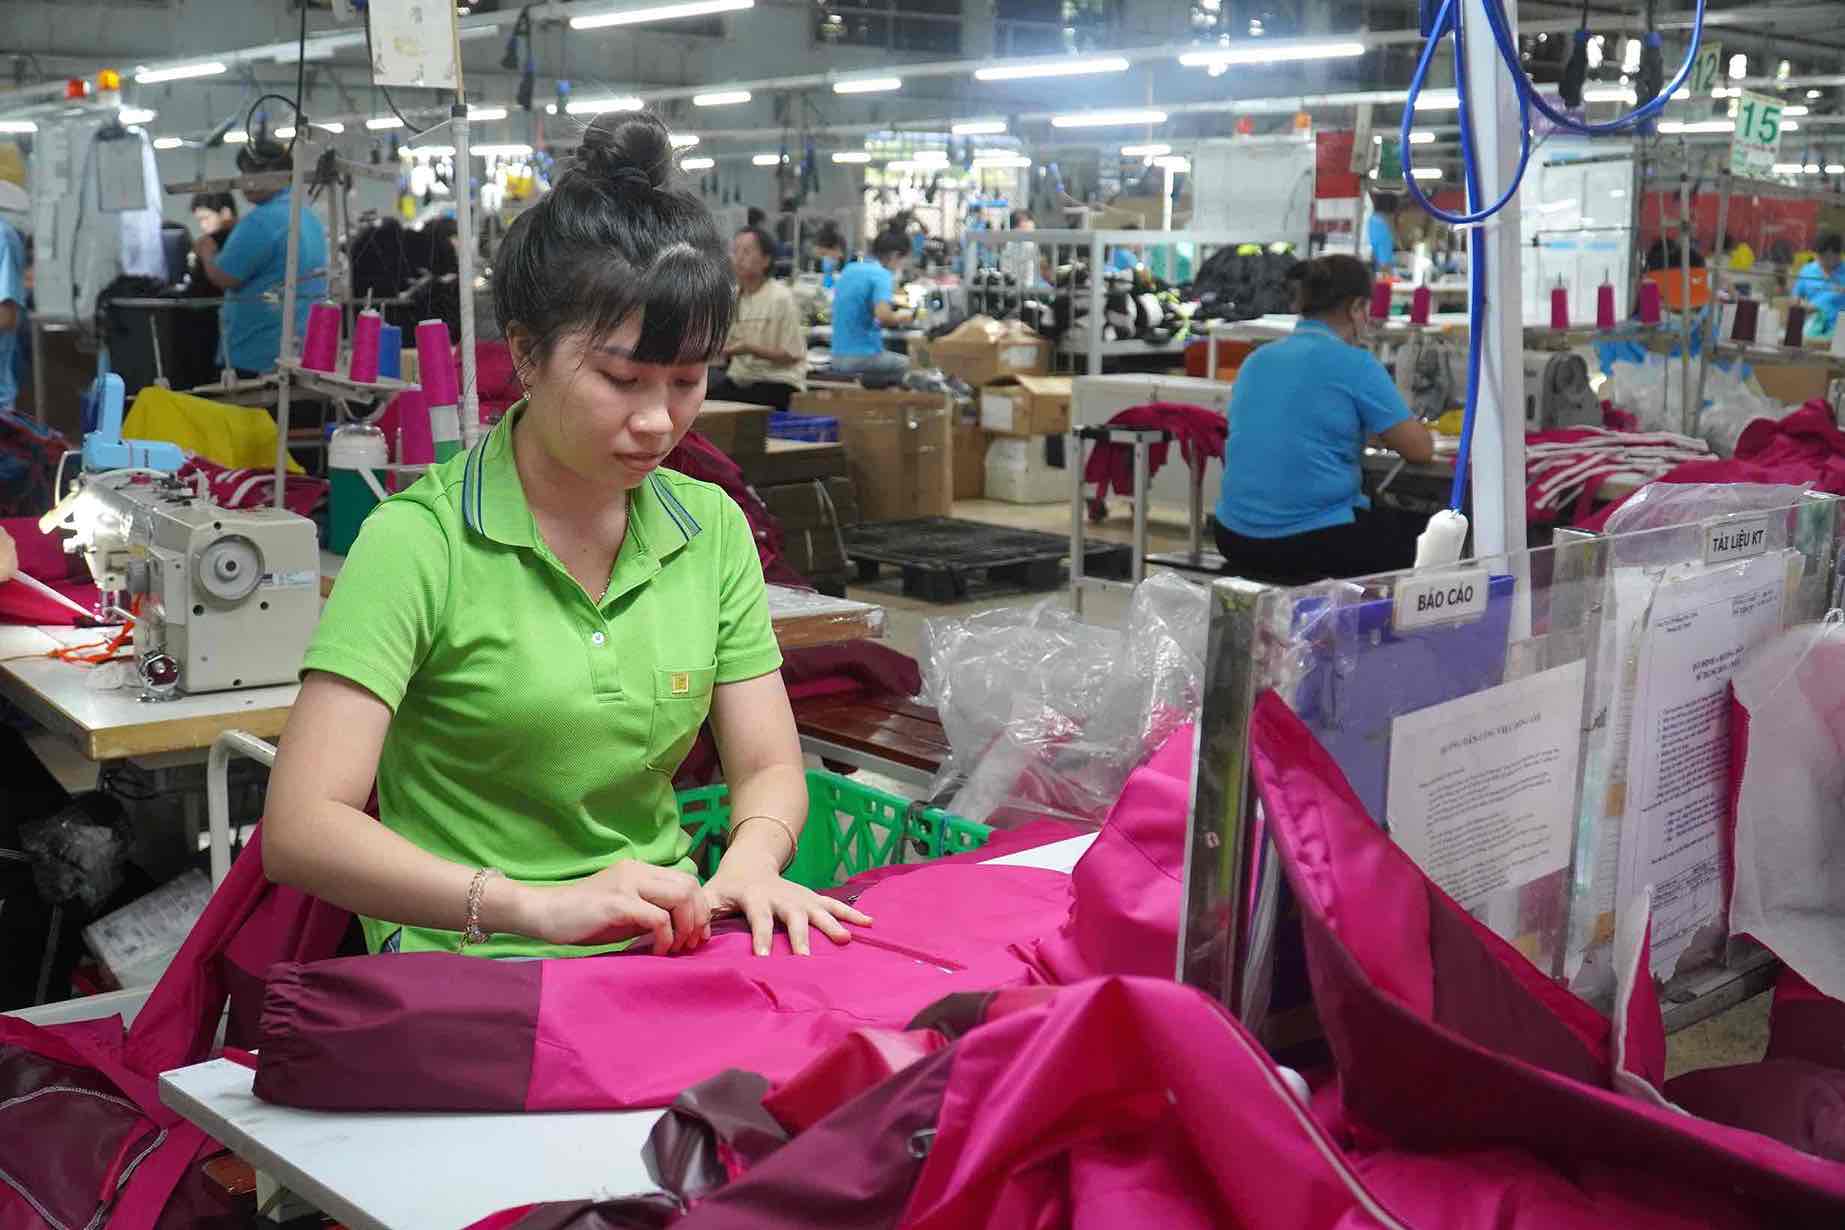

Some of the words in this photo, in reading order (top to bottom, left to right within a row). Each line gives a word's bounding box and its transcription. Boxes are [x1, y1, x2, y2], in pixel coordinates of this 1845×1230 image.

[1693, 52, 1717, 90] 12
[1743, 101, 1780, 144] 15
[1752, 530, 1764, 545] KT
[1417, 586, 1444, 611] BÁO
[1447, 582, 1473, 605] CÁO
